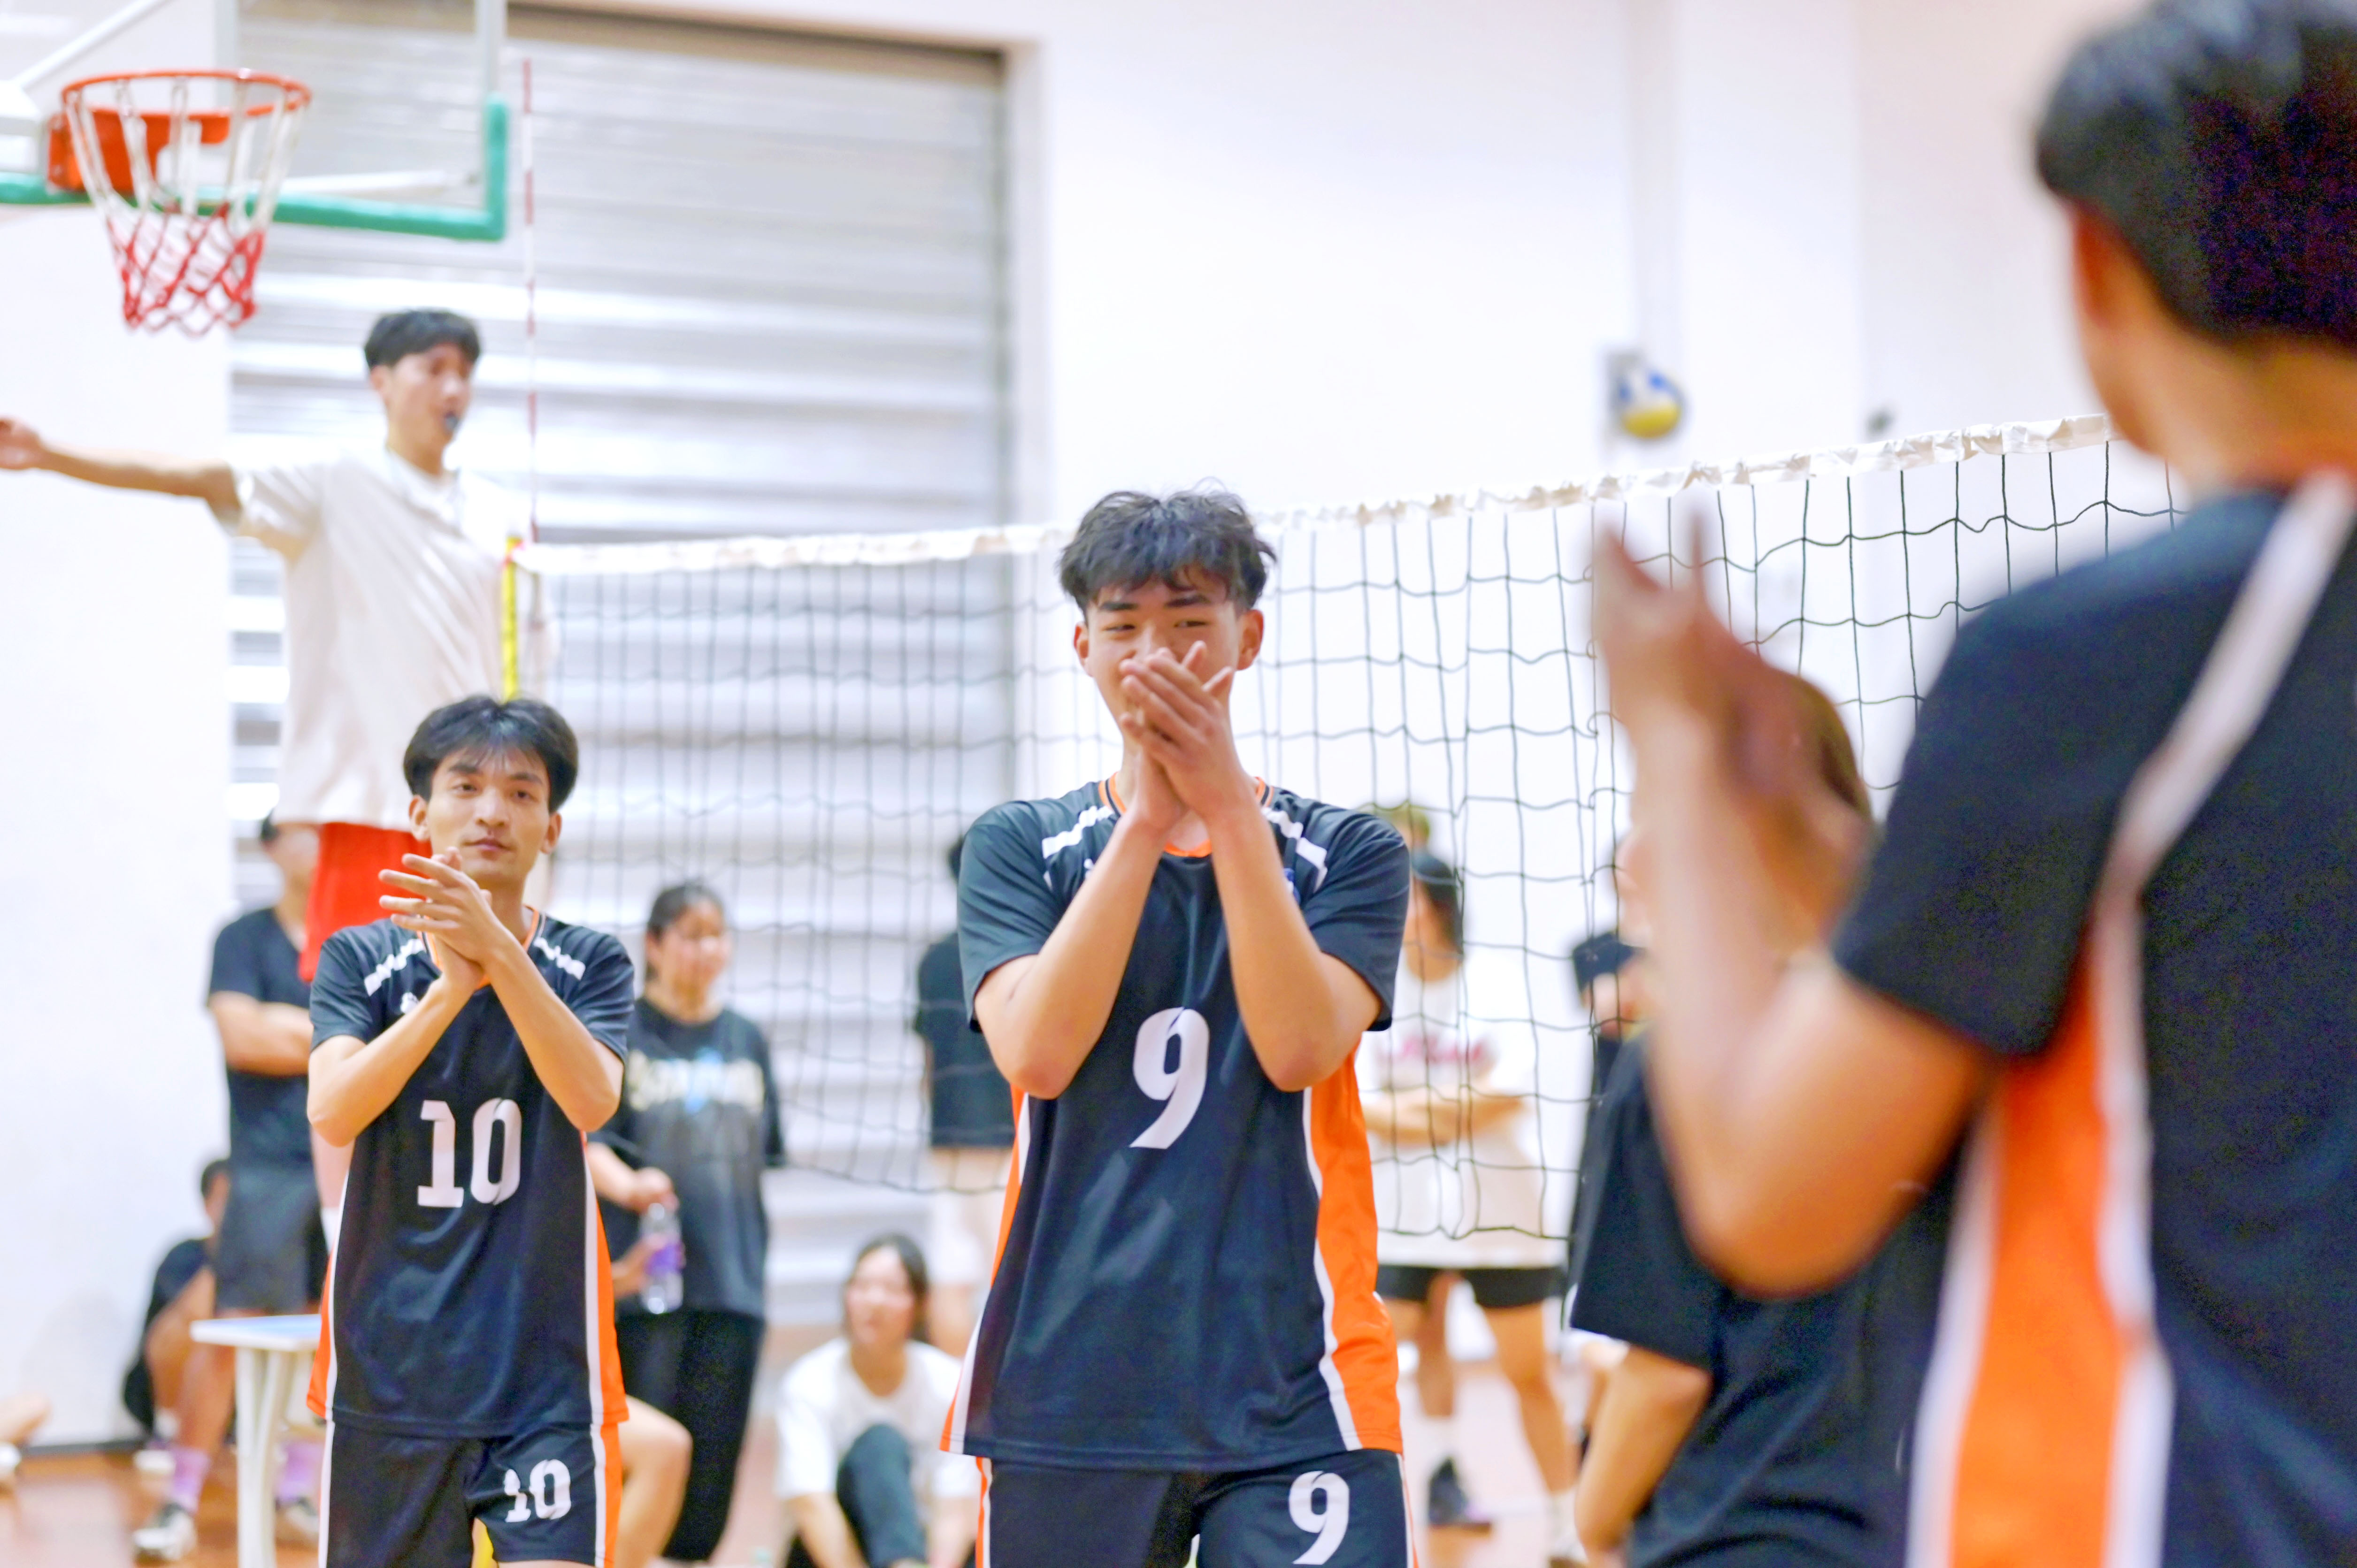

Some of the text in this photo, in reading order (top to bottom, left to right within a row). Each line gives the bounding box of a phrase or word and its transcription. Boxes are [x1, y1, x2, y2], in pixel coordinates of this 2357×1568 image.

[1129, 1006, 1210, 1149] 9
[417, 1097, 522, 1208] 10
[503, 1459, 572, 1523] 10
[1289, 1470, 1350, 1565] 9
